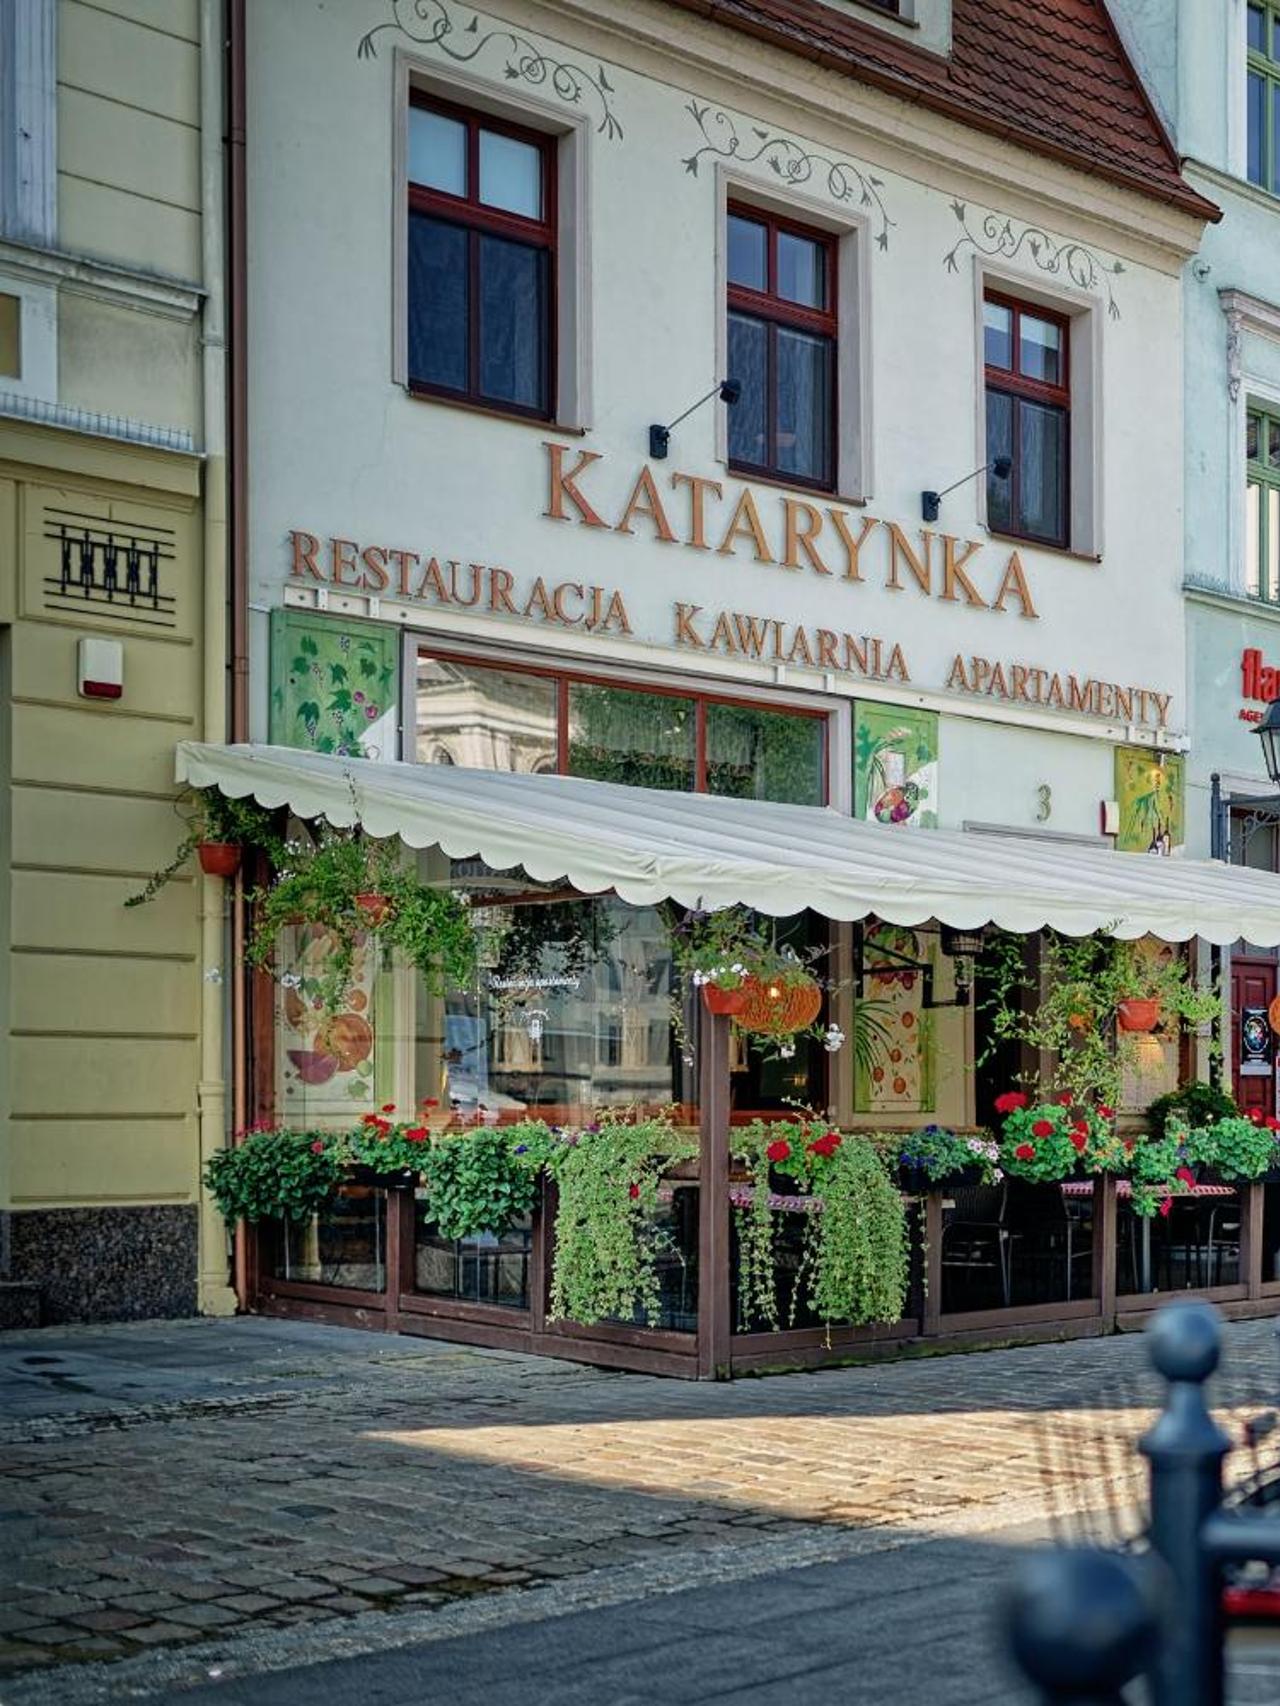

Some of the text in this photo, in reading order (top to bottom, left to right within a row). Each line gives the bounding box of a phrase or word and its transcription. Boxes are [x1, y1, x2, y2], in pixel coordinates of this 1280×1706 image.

[543, 441, 1040, 618] KATARYNKA
[288, 530, 1174, 727] RESTAURACJA KAWIARNIA APARTAMENTY
[1037, 785, 1053, 822] 3
